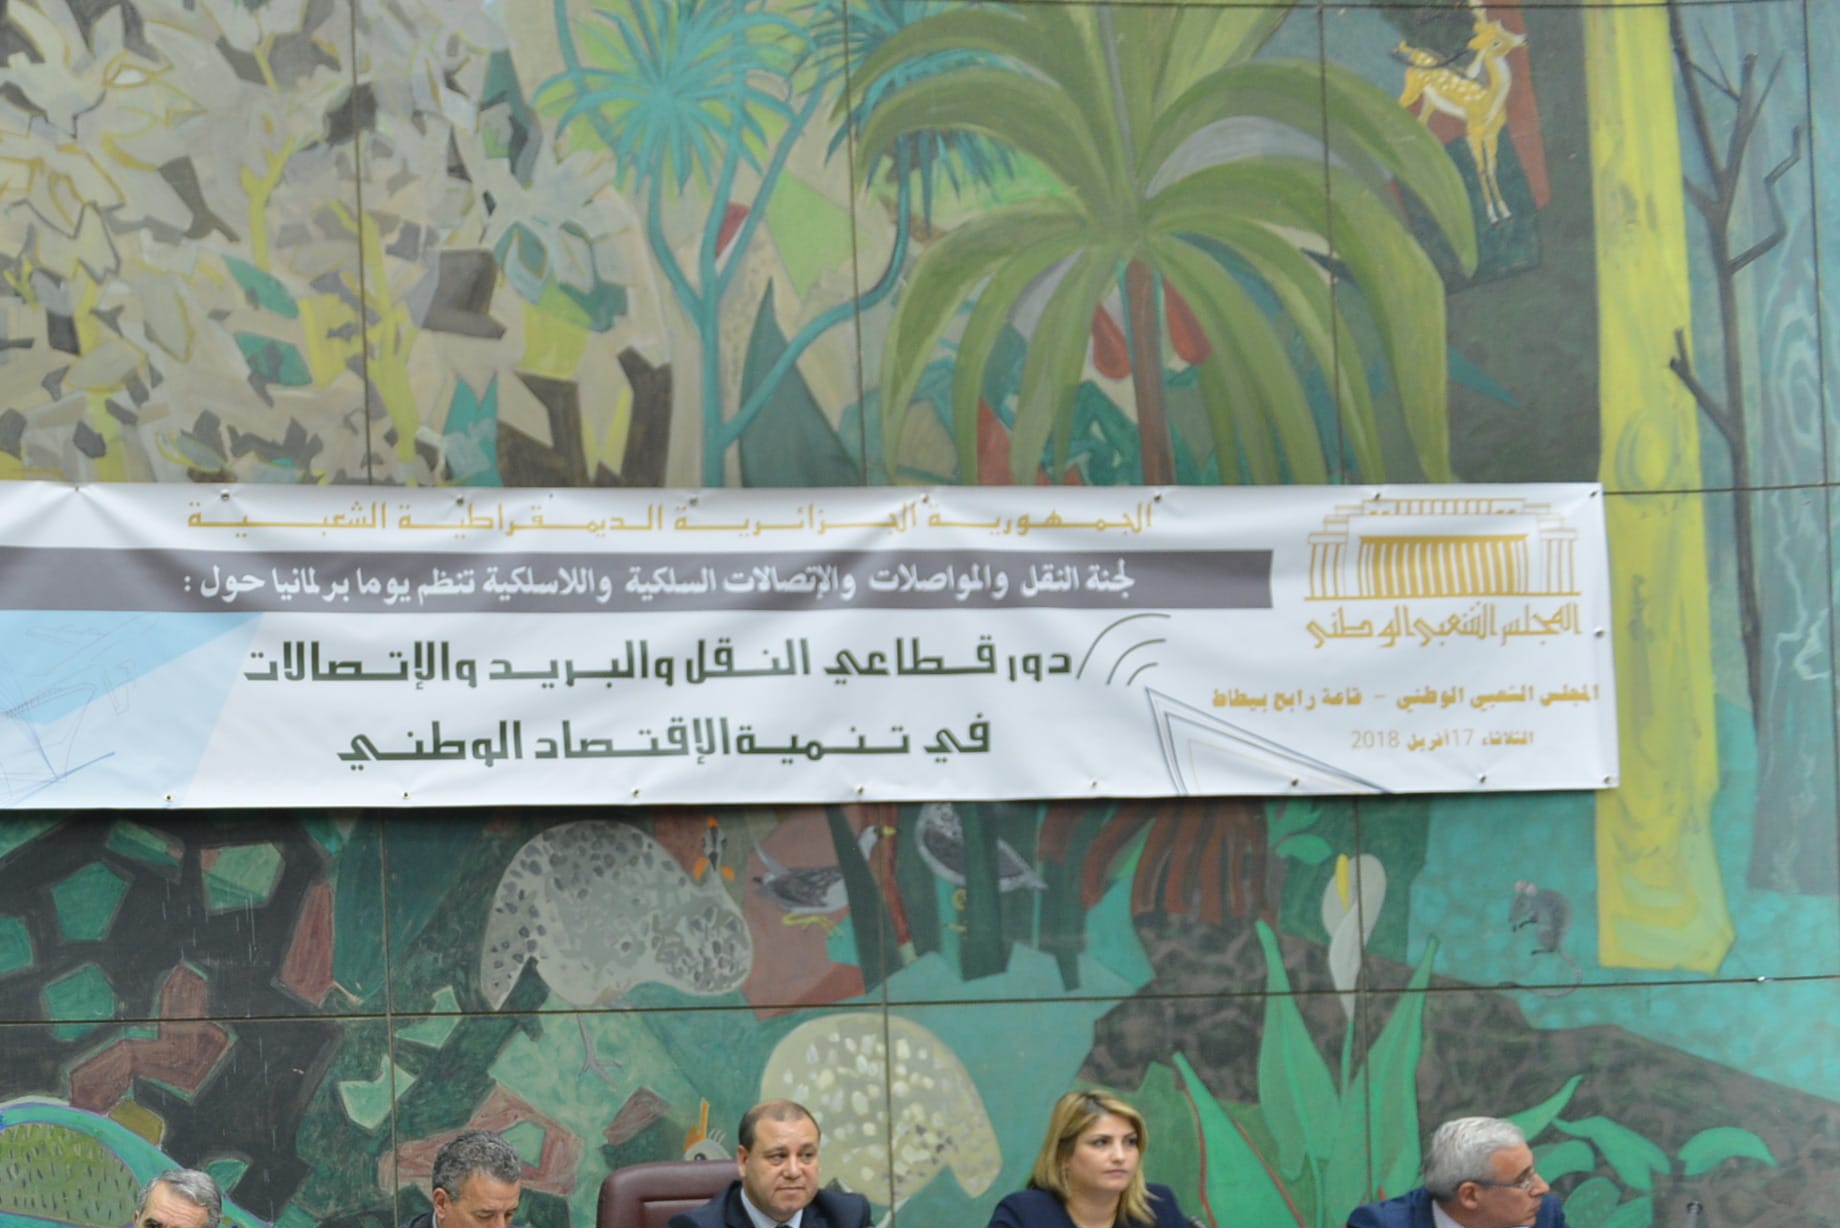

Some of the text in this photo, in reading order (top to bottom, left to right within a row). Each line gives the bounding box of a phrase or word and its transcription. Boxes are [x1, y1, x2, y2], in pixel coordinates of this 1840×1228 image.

[187, 500, 1154, 538] الجمهورية الجزائرية الديمقراطية الشعبية
[200, 565, 265, 602] حول
[271, 567, 350, 603] برلمانيا
[357, 567, 411, 603] يوما
[417, 567, 476, 604] تنظم
[482, 566, 613, 603] واللاسلكية
[625, 565, 717, 597] السلكية
[722, 564, 857, 602] والإتصالات
[868, 563, 1009, 601] والمواصلات
[1020, 564, 1080, 597] النقل
[1085, 557, 1136, 600] لجنة
[1304, 604, 1417, 649] الوطني
[242, 634, 1072, 690] دور قطاعي النقل والبريد والإتصالات
[1272, 687, 1317, 712] رابح
[1321, 686, 1363, 708] قاعة
[1396, 684, 1465, 713] الوطني
[1539, 683, 1601, 709] المجلس
[335, 712, 992, 771] في تنمية الإقتصاد الوطني
[1351, 731, 1401, 750] 2018
